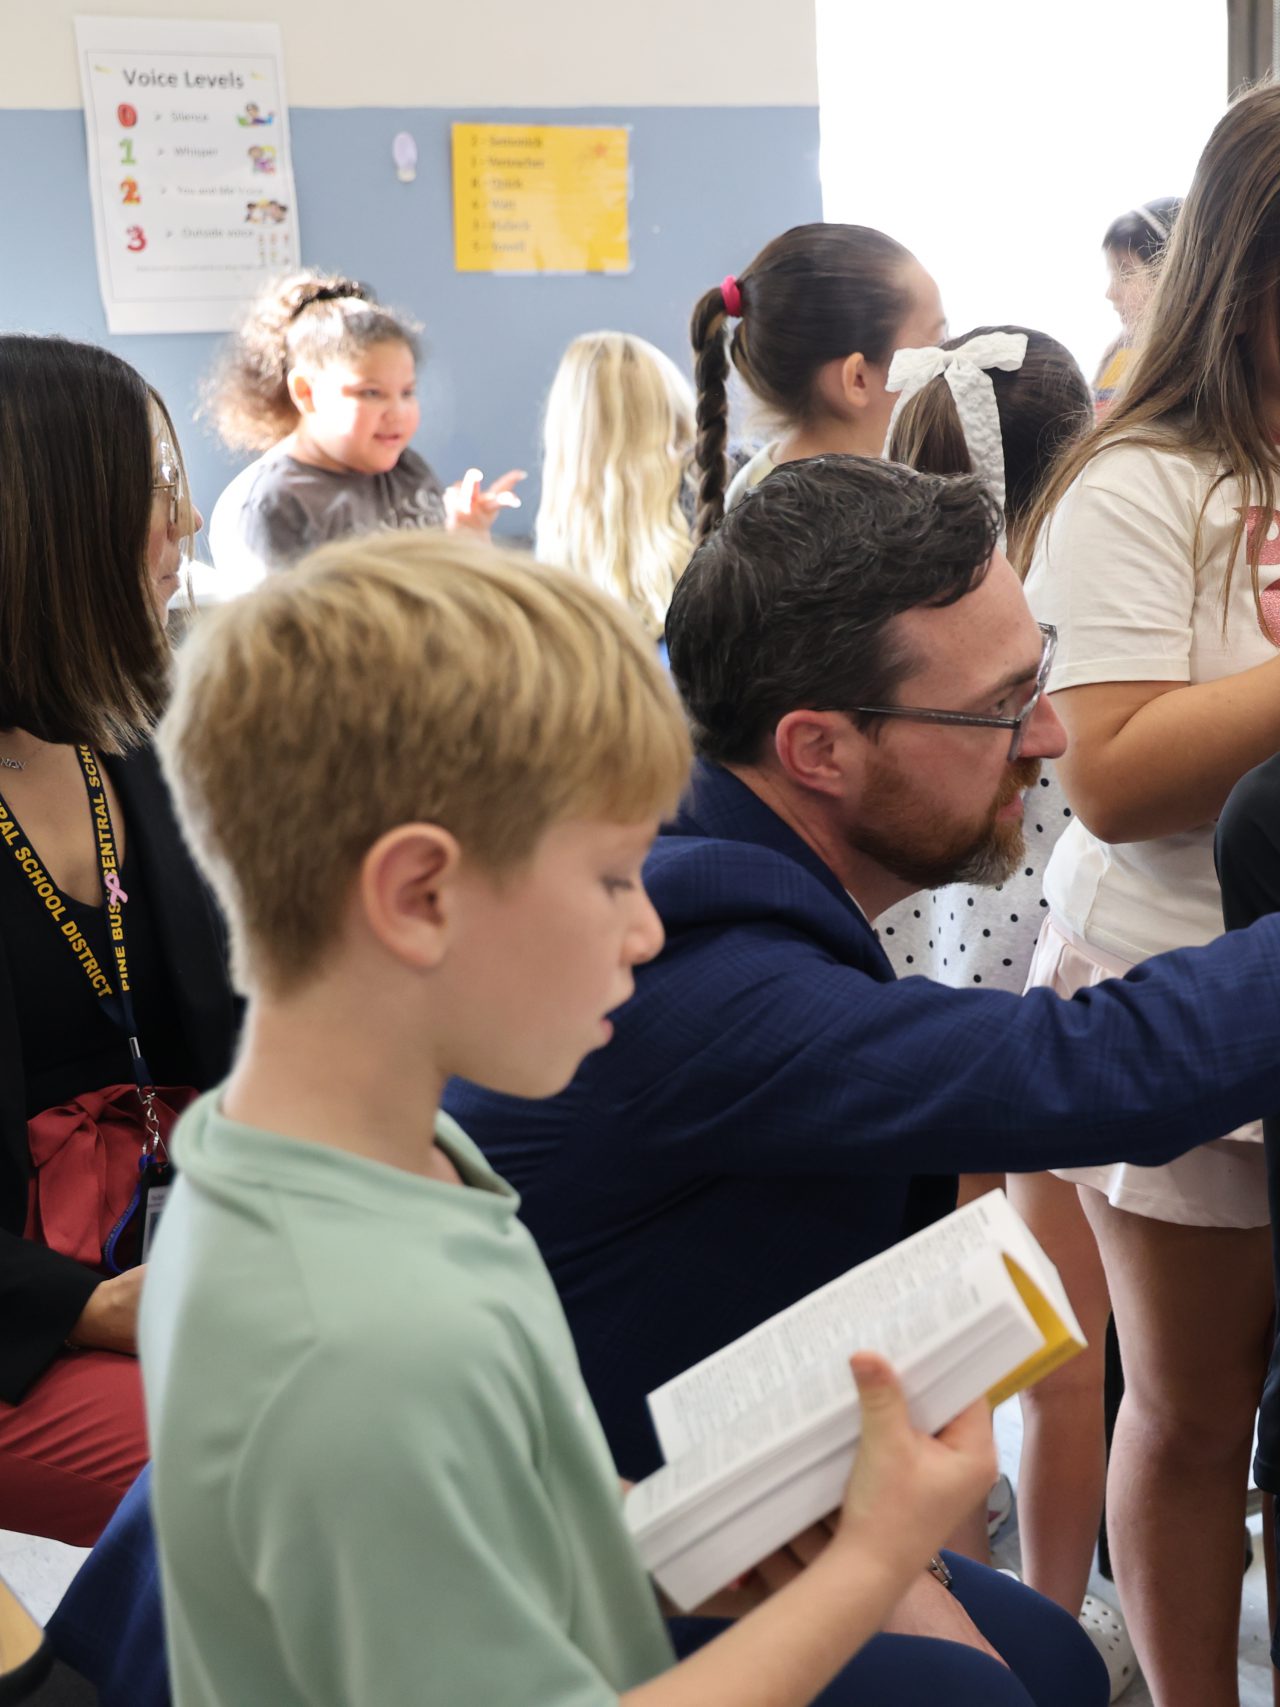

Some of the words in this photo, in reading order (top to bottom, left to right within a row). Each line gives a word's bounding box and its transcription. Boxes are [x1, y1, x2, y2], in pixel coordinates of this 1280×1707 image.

[122, 69, 178, 88] Voice
[184, 70, 244, 89] Levels
[117, 103, 138, 128] 0
[118, 138, 137, 166] 1
[120, 175, 142, 205] 2
[126, 225, 148, 254] 3
[15, 846, 66, 922] SCHOOL
[61, 920, 113, 997] DISTRICT
[106, 889, 124, 940] BUS
[115, 946, 130, 991] PINE
